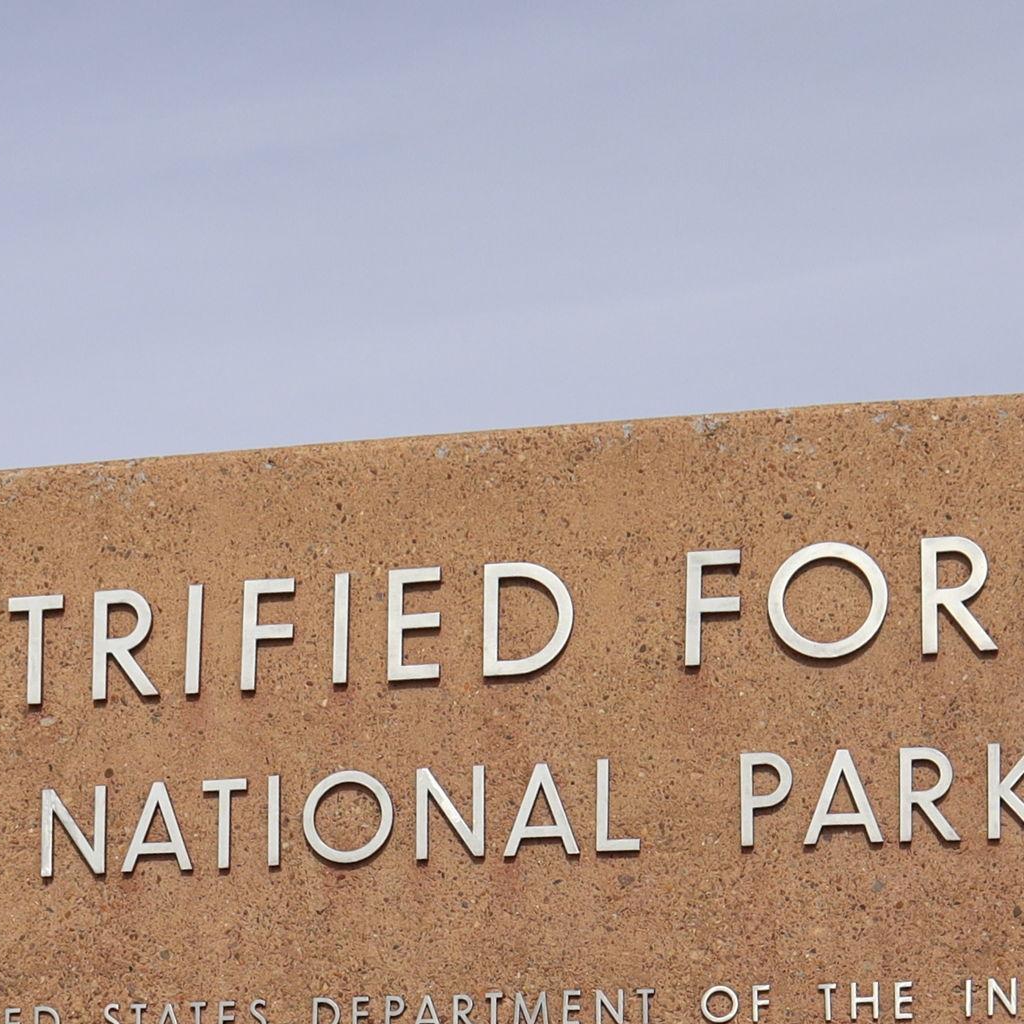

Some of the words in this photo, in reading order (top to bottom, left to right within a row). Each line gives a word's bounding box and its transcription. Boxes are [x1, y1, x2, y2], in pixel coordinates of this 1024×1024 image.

[684, 535, 999, 667] FOR
[39, 757, 641, 878] NATIONAL
[739, 742, 1024, 847] PARK
[700, 984, 771, 1023] OF
[818, 981, 913, 1021] THE
[964, 977, 1017, 1018] IN
